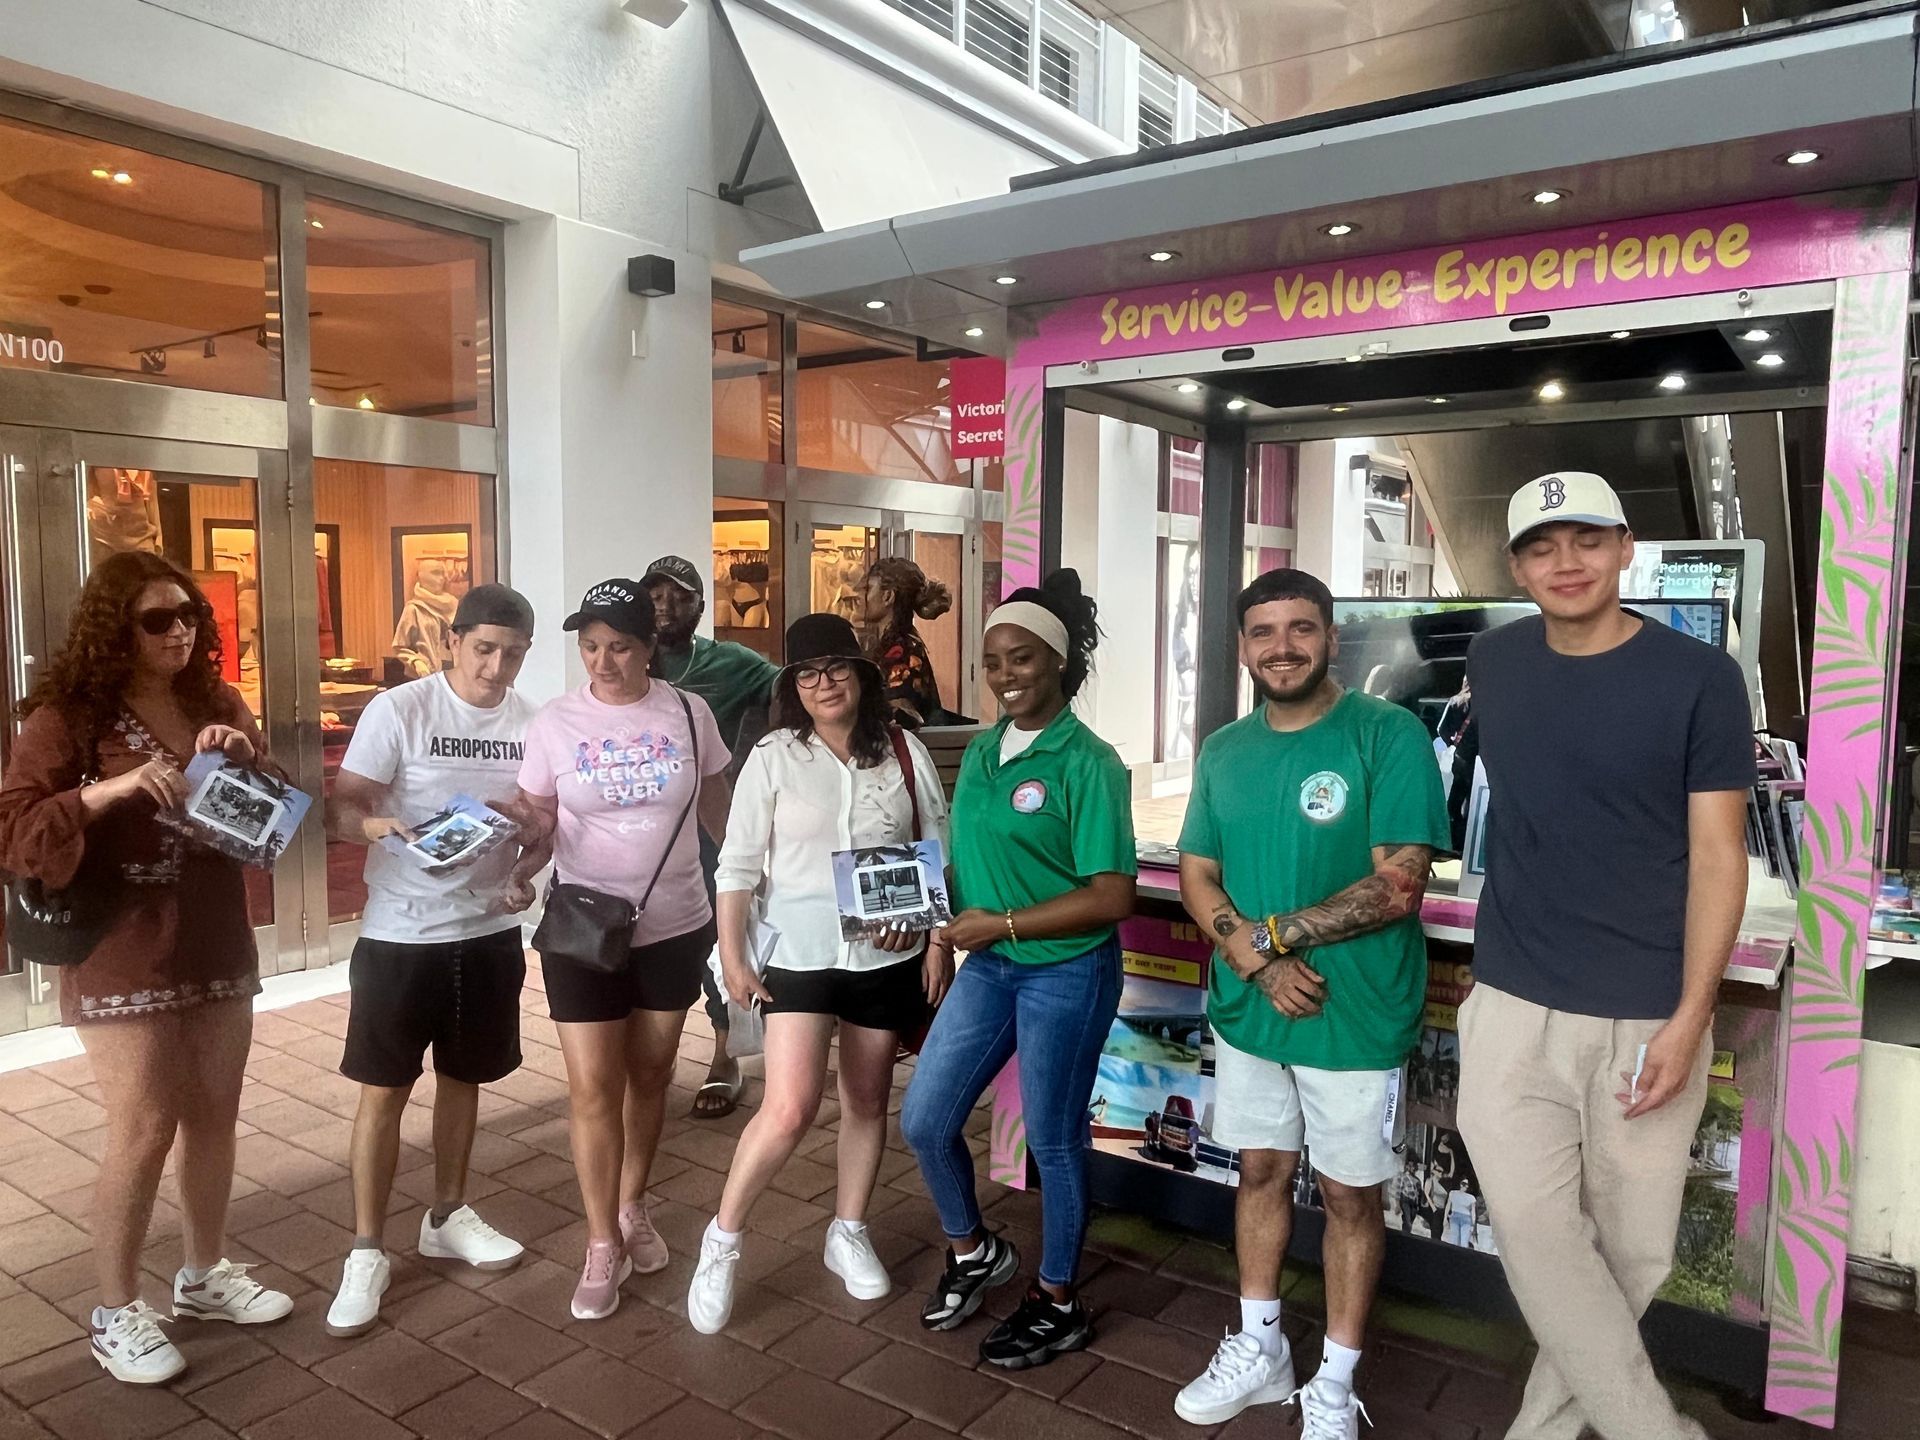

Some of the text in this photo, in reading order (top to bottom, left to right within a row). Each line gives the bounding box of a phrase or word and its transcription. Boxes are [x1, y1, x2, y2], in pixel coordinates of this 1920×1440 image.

[0, 333, 63, 363] N100
[957, 400, 1005, 418] Victori
[957, 429, 1004, 444] Secret
[1539, 477, 1566, 511] B
[1659, 562, 1723, 574] Portable
[598, 746, 652, 764] BEST
[575, 759, 683, 784] WEEKEND
[603, 780, 661, 801] EVER
